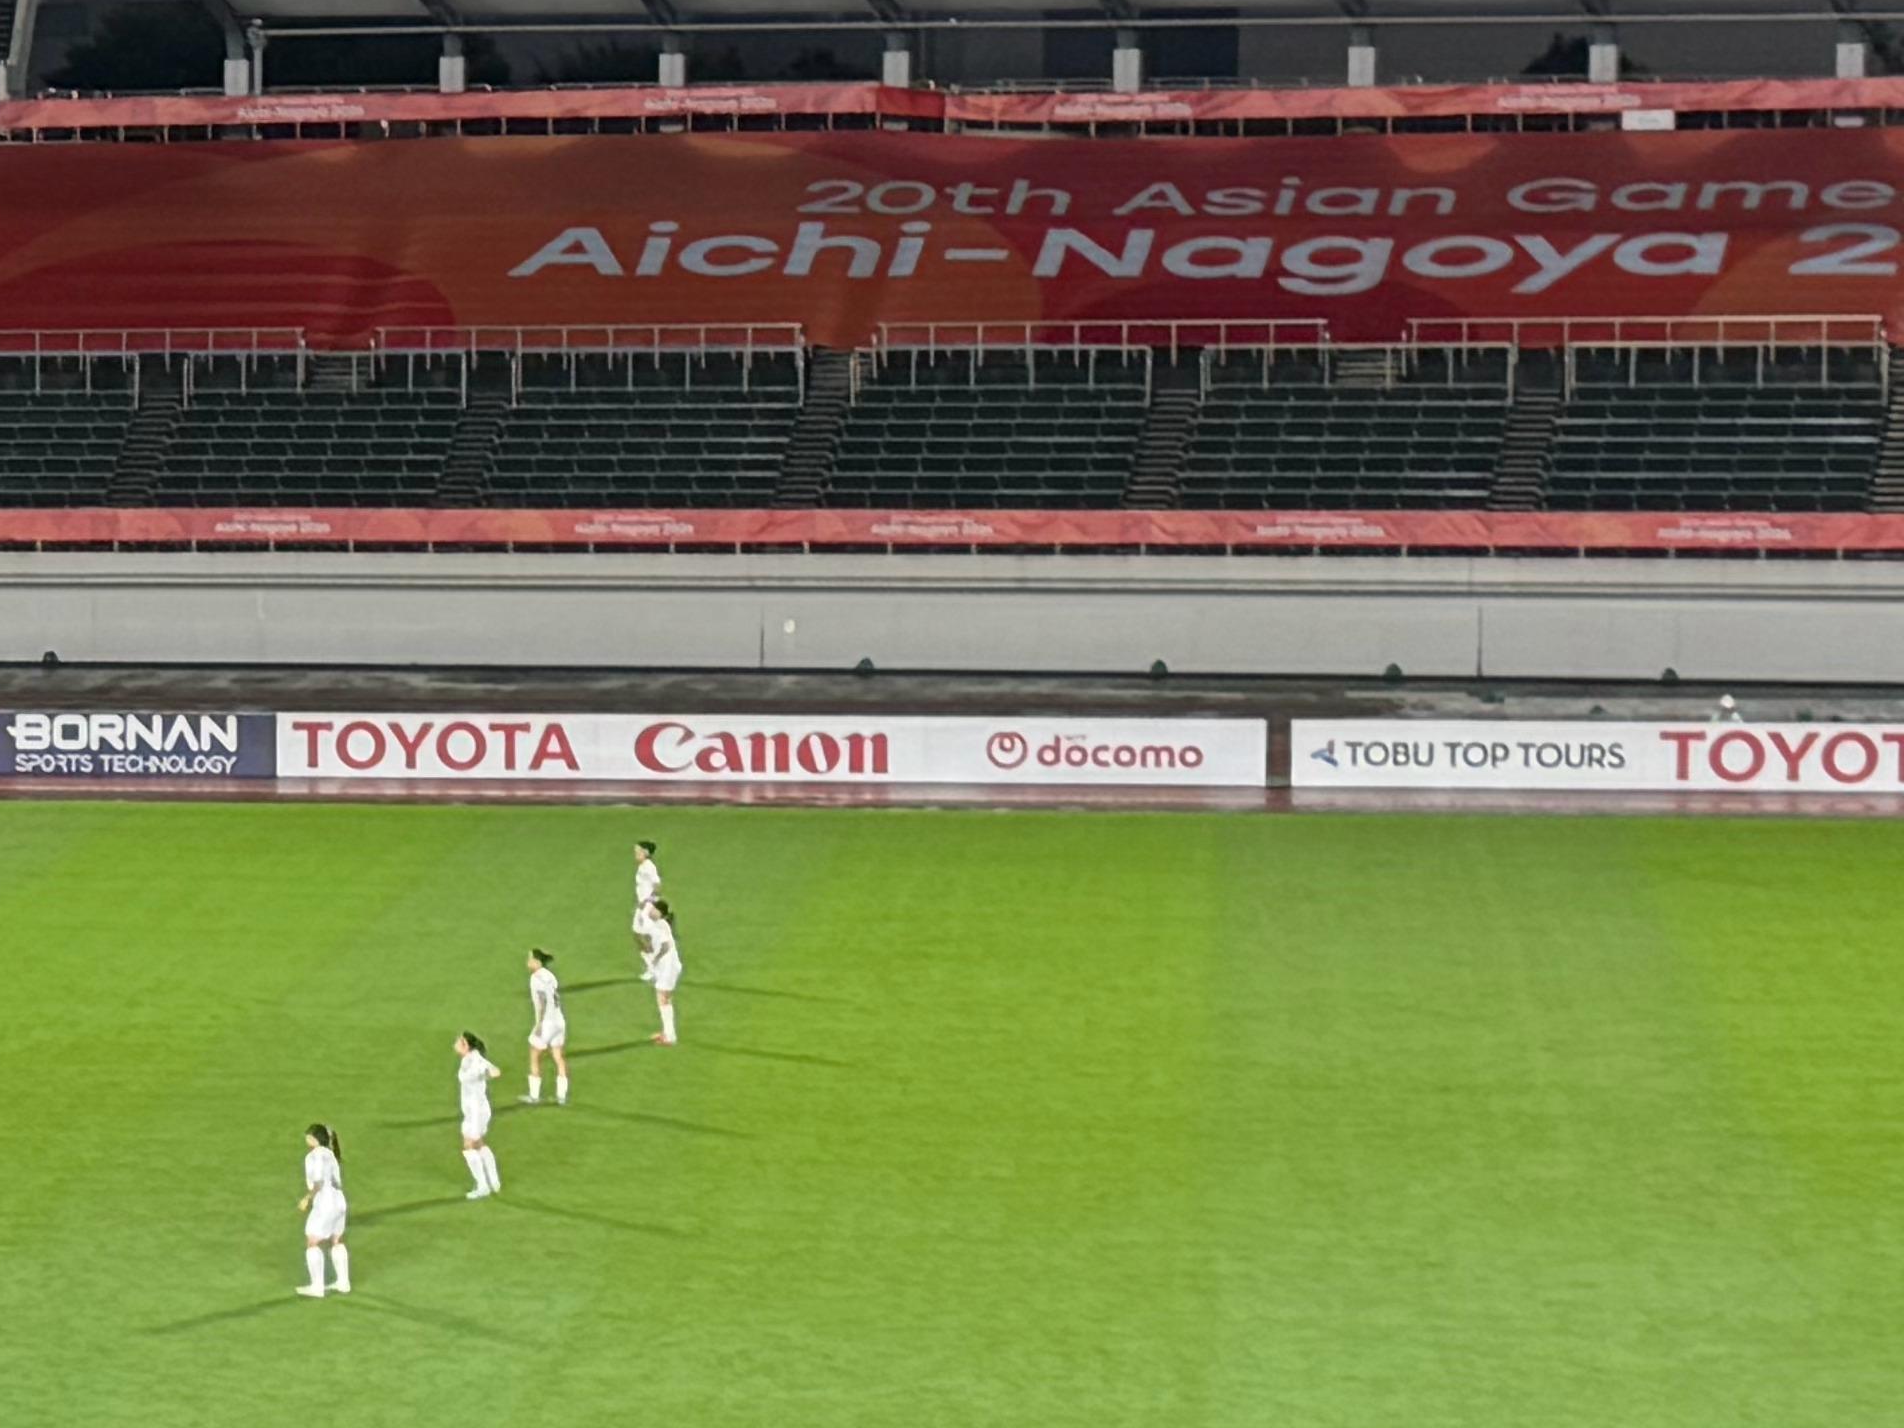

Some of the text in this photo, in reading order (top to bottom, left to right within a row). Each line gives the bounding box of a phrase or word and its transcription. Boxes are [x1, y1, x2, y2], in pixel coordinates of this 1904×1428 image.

[796, 178, 1071, 215] 20th
[1112, 176, 1457, 215] Asian
[506, 220, 1730, 294] Aichi-Nagoya
[7, 713, 238, 752] BORNAN
[292, 721, 581, 771] TOYOTA
[634, 722, 889, 775] Canon
[1037, 735, 1204, 768] docomo
[15, 755, 237, 774] SPORTS TECHNOLOGY
[1345, 741, 1626, 769] TOBU TOP TOURS
